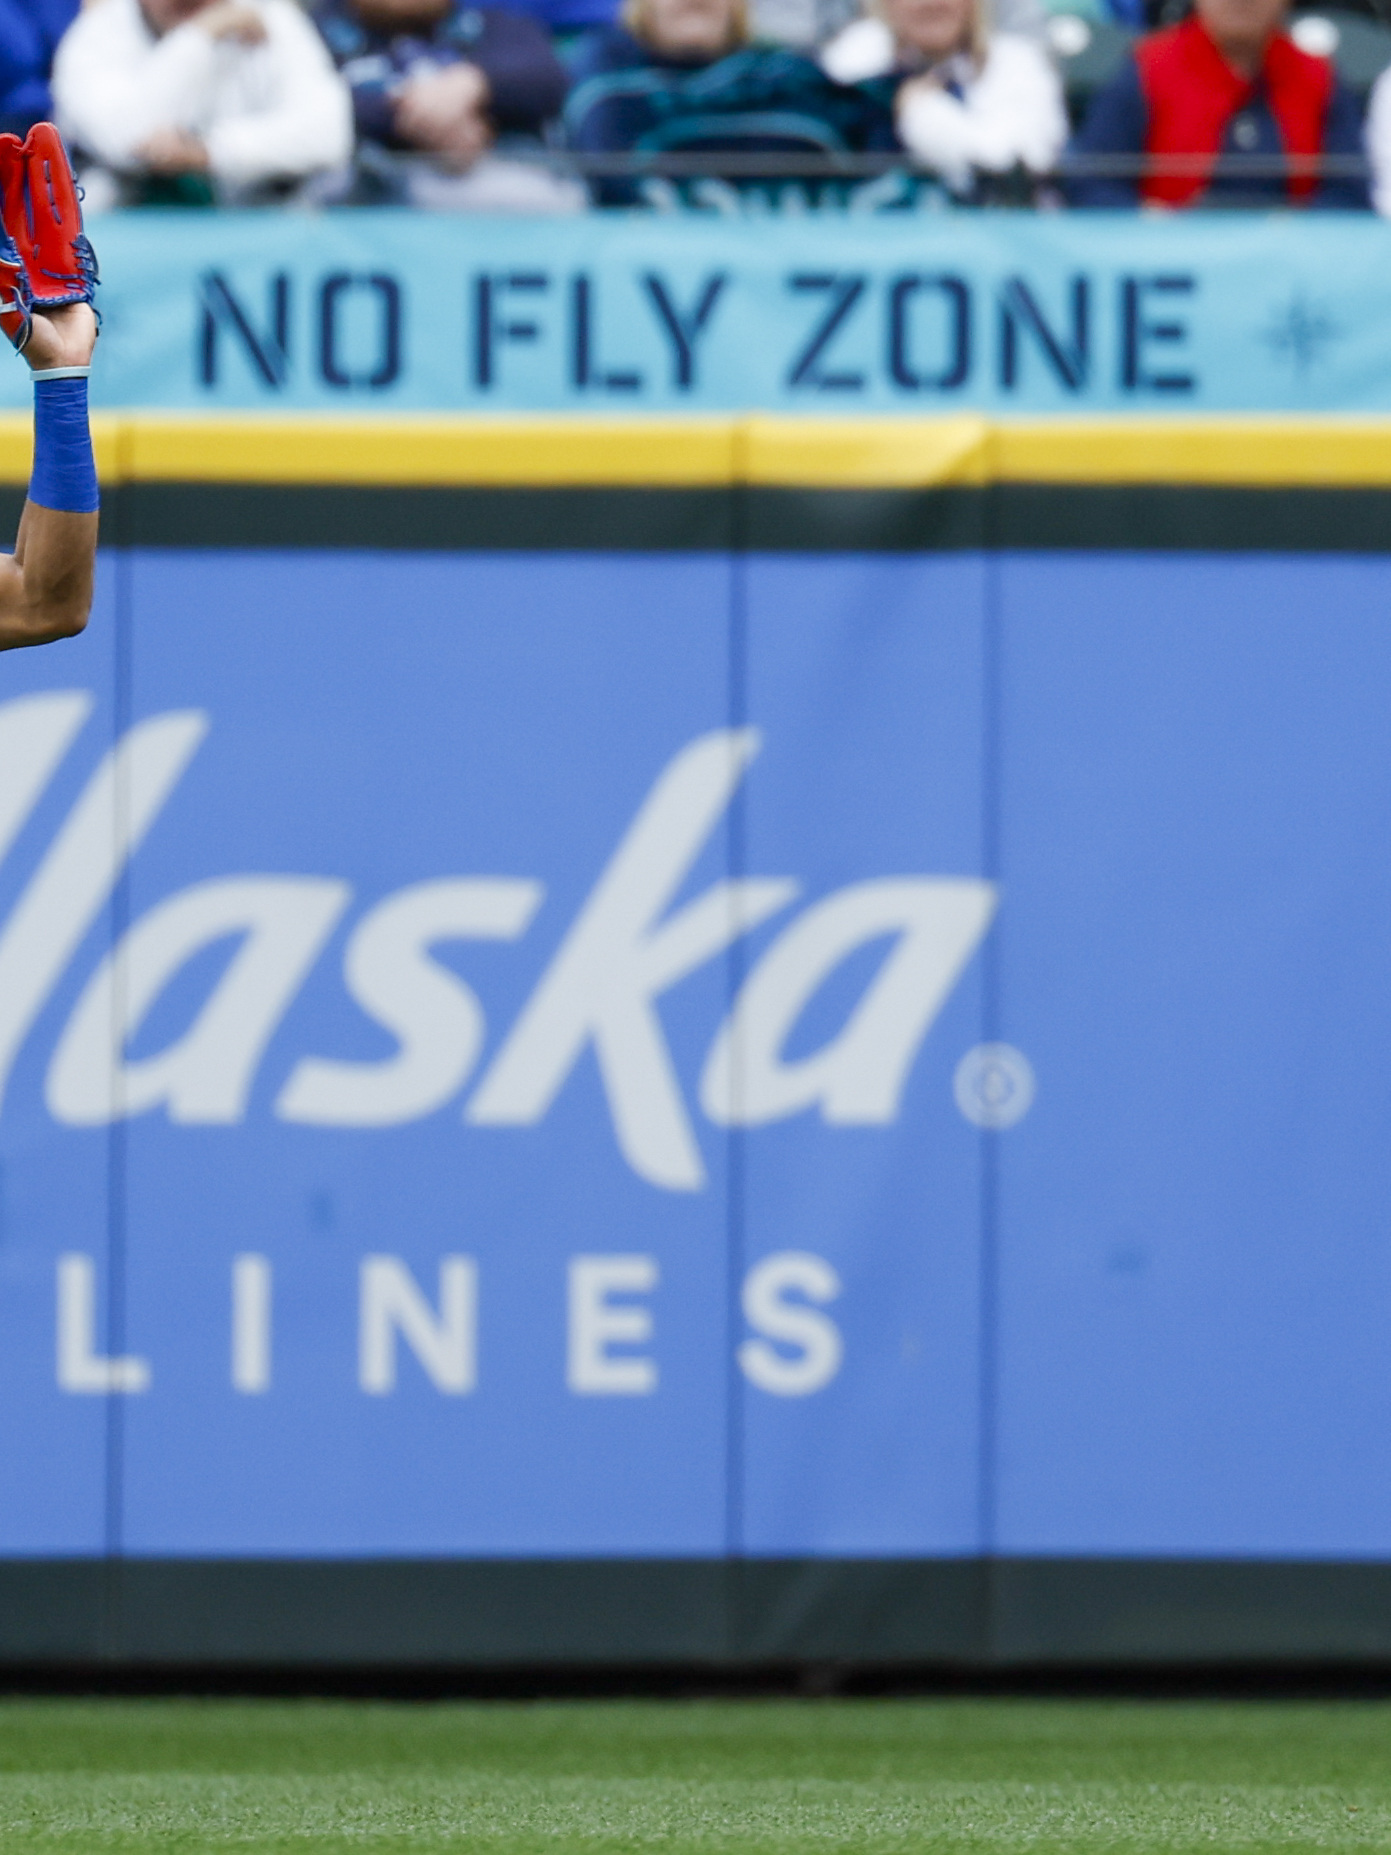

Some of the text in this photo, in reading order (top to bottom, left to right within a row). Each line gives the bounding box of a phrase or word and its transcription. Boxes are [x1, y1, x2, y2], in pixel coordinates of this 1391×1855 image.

[200, 271, 1197, 393] NO FLY ZONE
